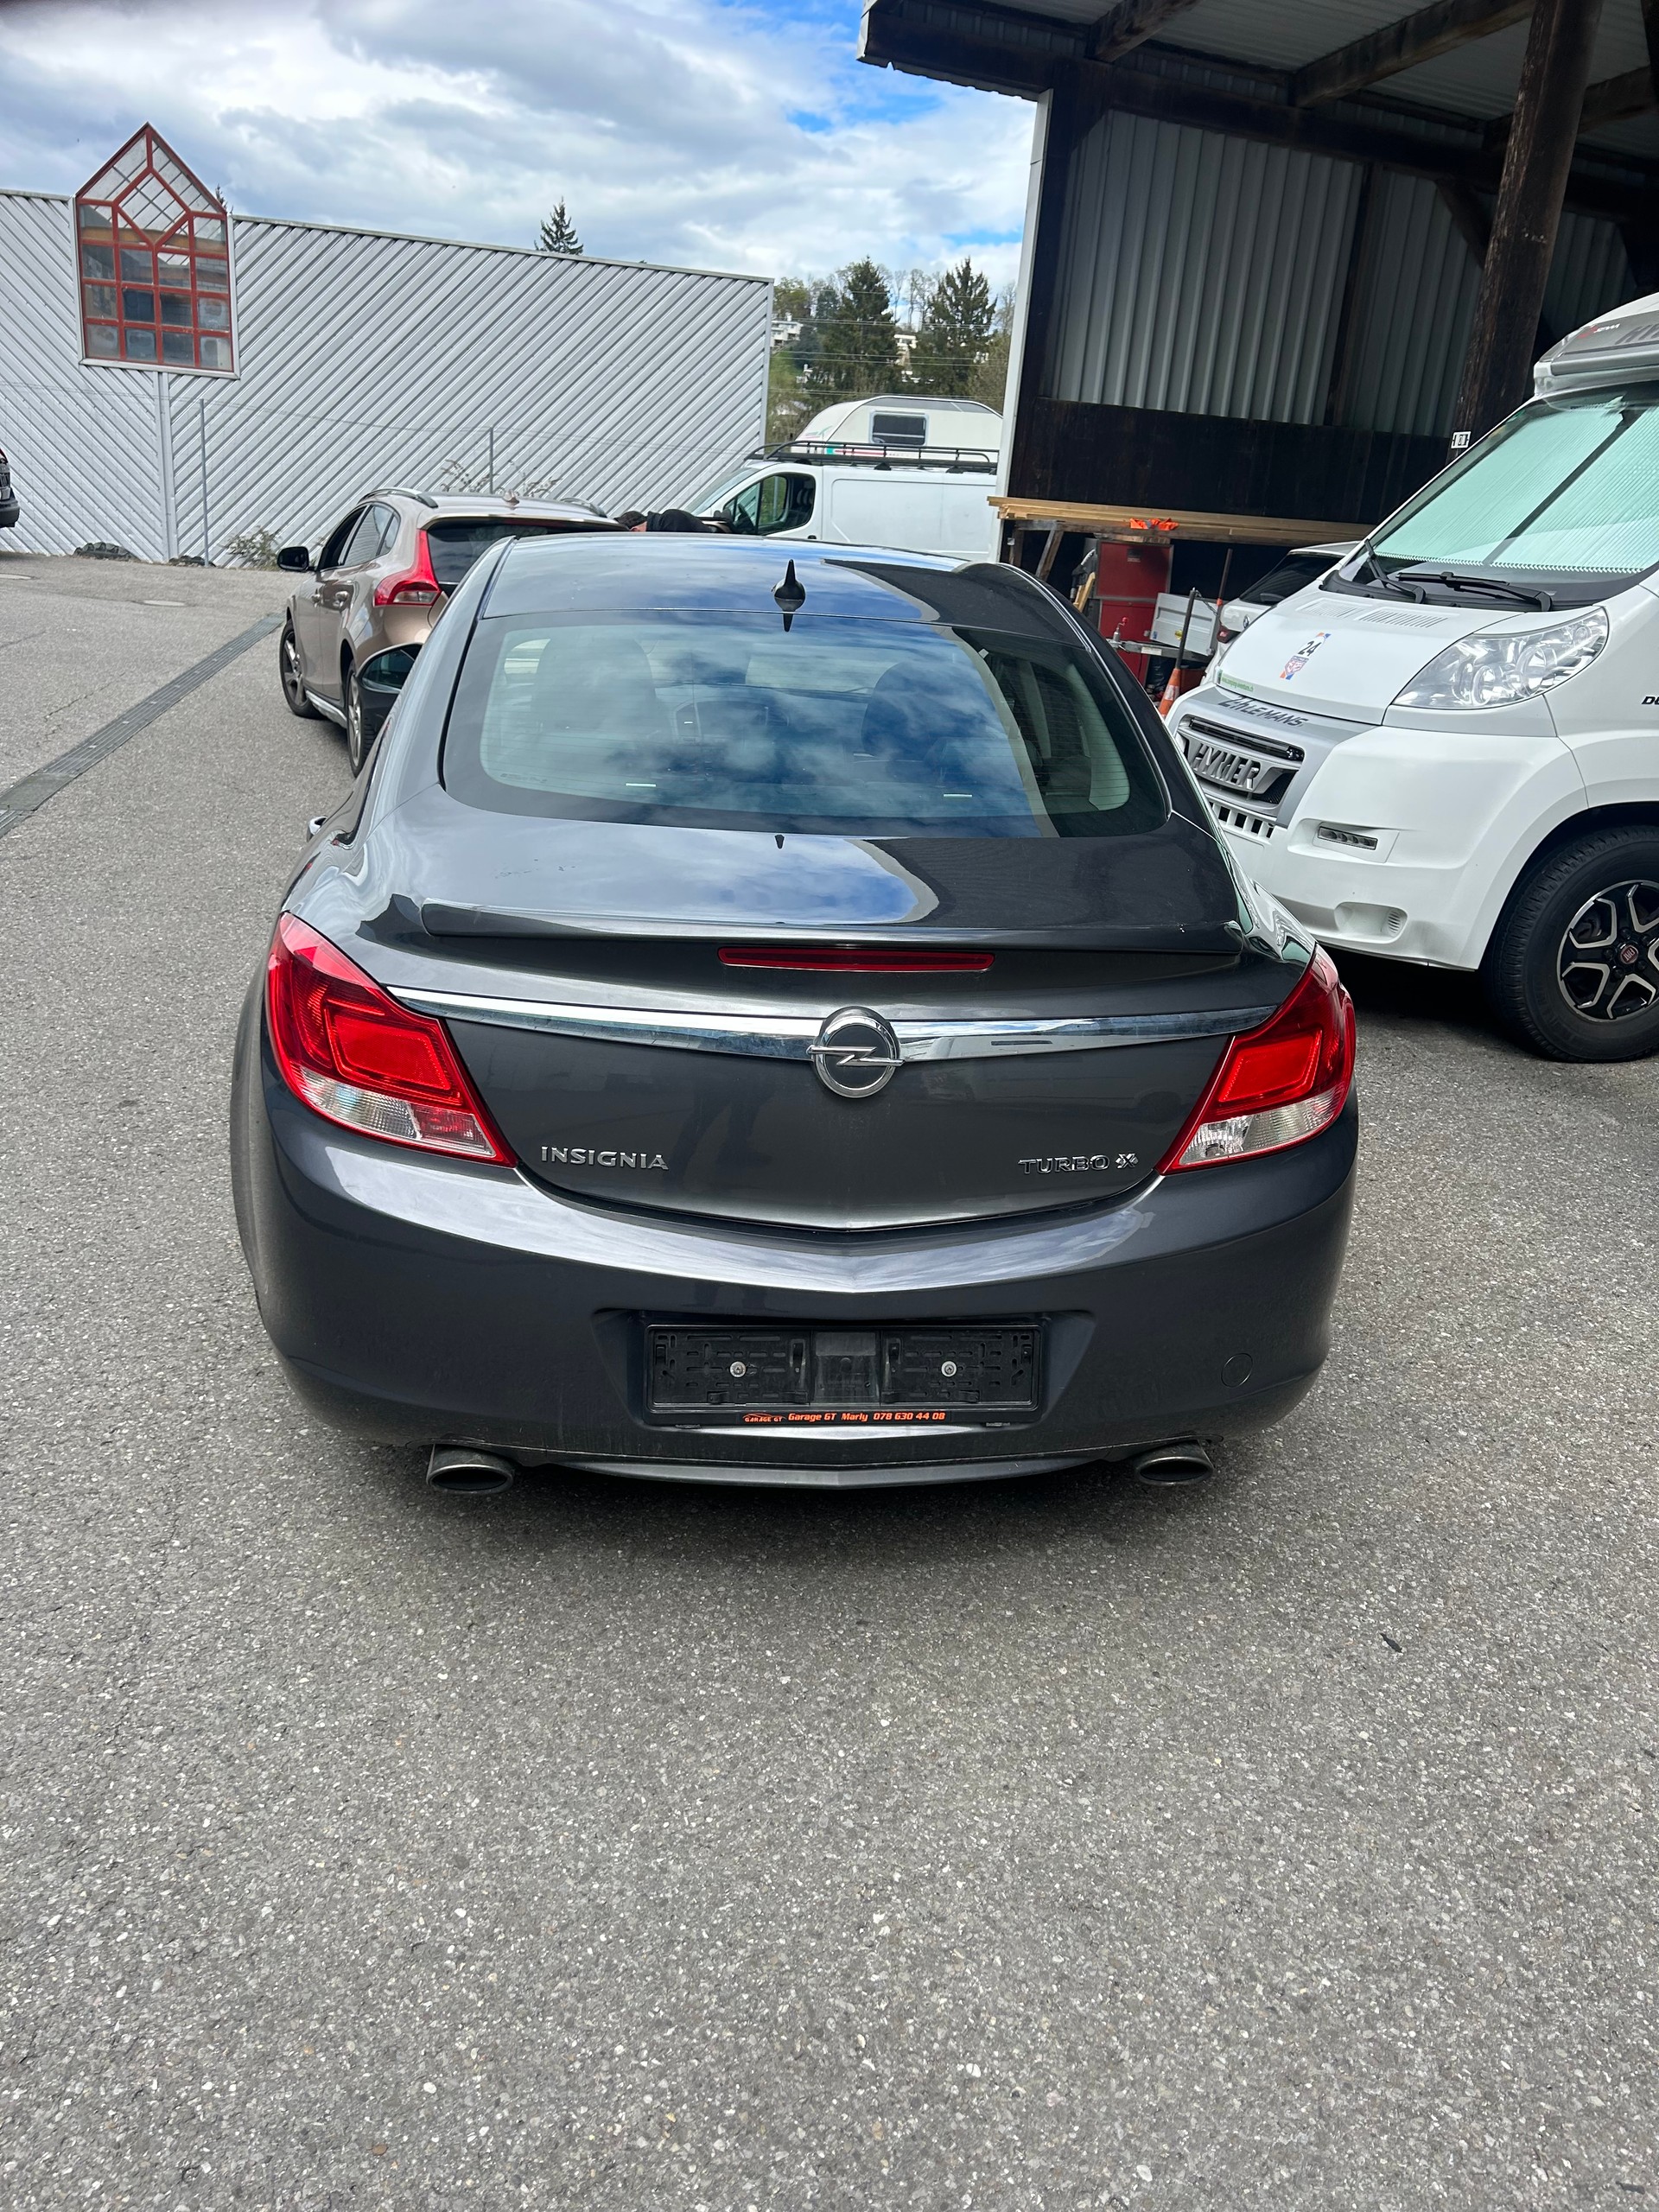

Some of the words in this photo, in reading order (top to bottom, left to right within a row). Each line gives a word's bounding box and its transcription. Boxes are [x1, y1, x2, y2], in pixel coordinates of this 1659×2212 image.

[1298, 640, 1321, 657] 24
[1257, 709, 1309, 726] MANS
[541, 1146, 669, 1170] INSIGNIA
[1018, 1154, 1110, 1174] TURBO
[788, 1413, 822, 1422] Garage
[842, 1413, 868, 1422] Marly
[874, 1412, 893, 1421] 078
[894, 1412, 913, 1421] 630
[916, 1412, 930, 1421] 44
[932, 1412, 946, 1421] 08
